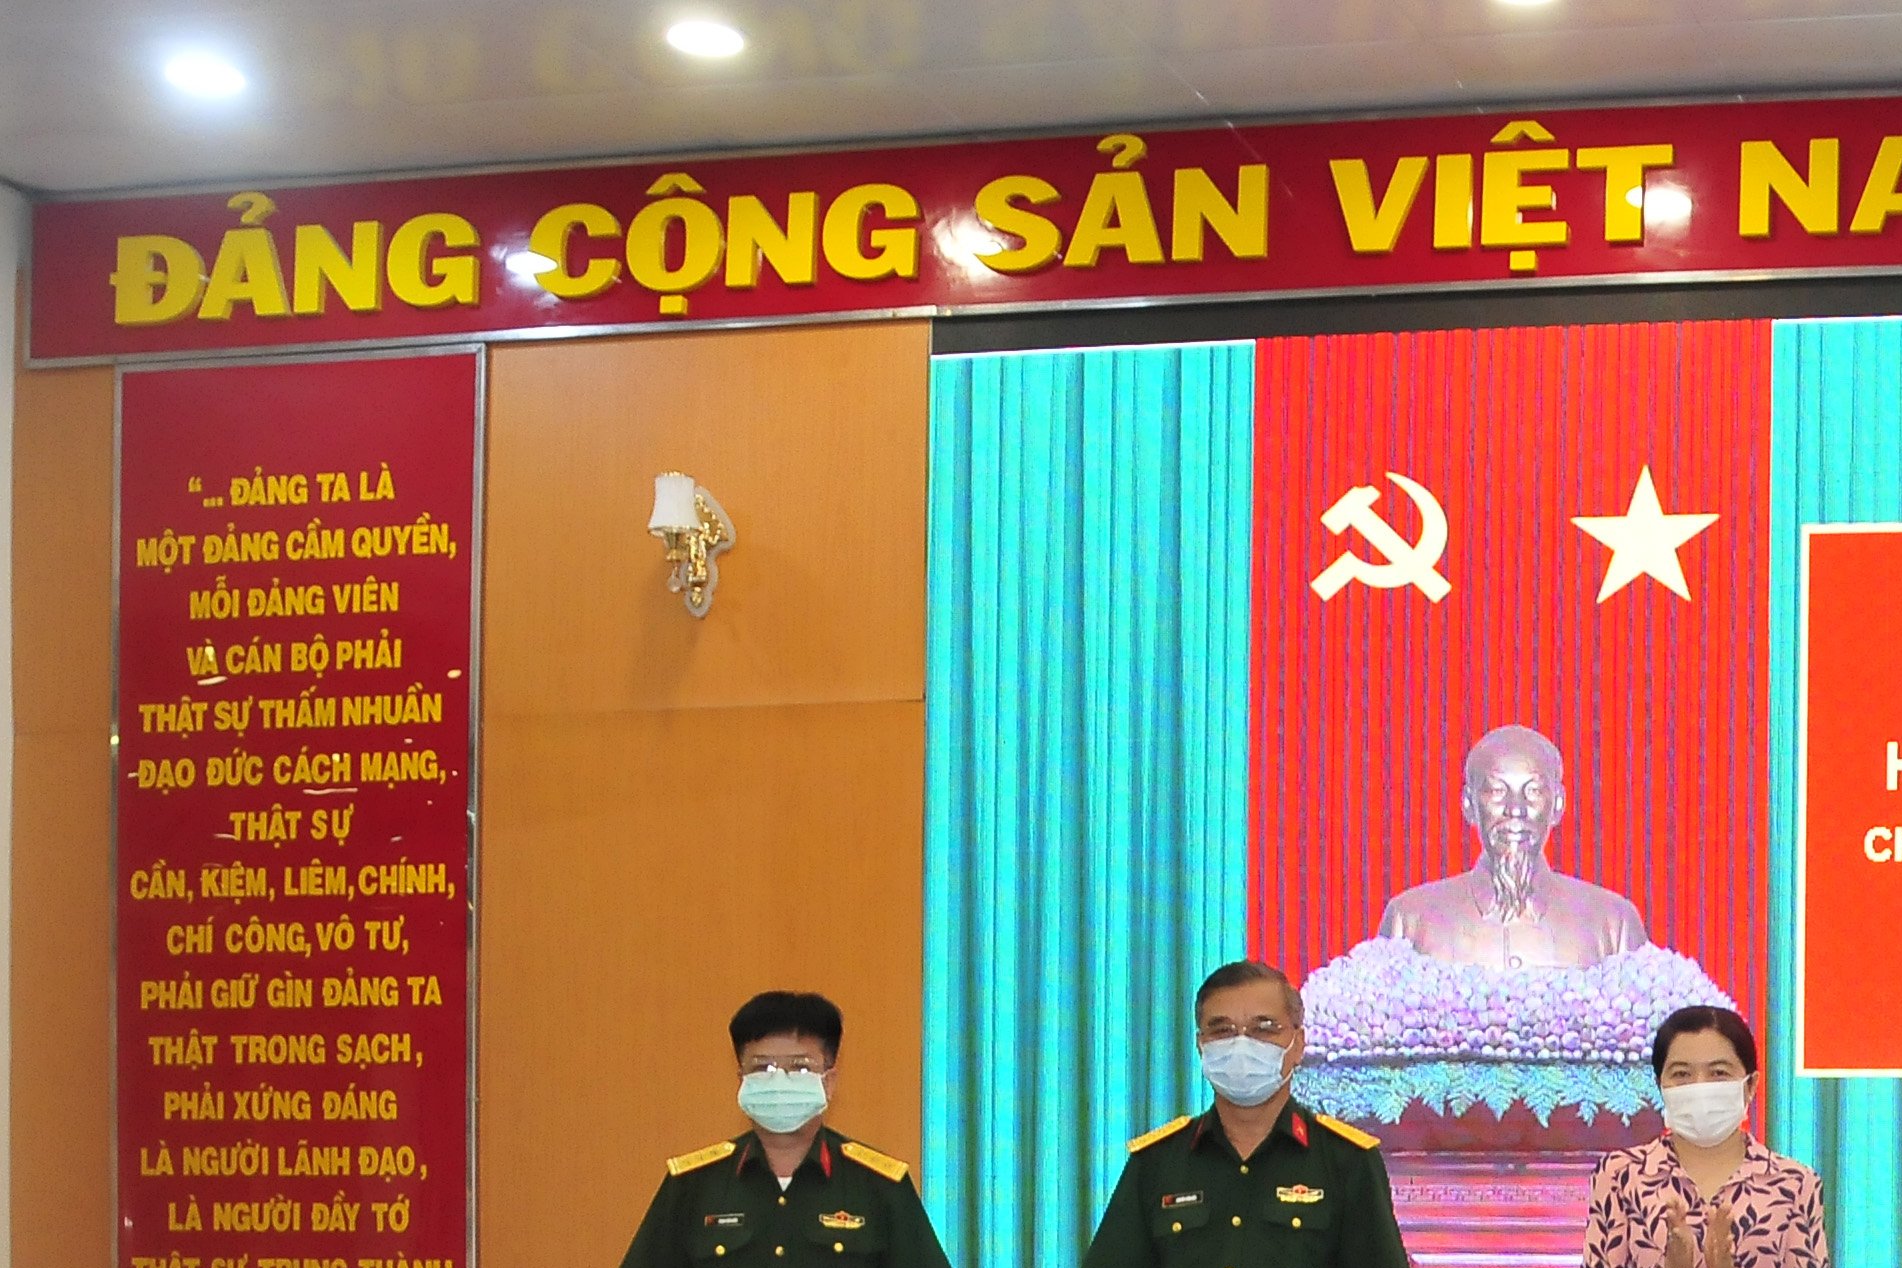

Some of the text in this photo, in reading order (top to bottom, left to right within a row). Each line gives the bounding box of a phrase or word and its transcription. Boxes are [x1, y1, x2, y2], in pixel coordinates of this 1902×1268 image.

[110, 190, 482, 326] ĐẢNG
[528, 172, 921, 316] CỘNG
[970, 133, 1270, 276] SẢN
[1329, 119, 1675, 272] VIỆT
[230, 466, 308, 506] ĐẢNG
[316, 472, 351, 502] TA
[360, 463, 395, 501] LÀ
[137, 512, 456, 573] MỘT ĐẢNG CẦM QUYỀN,
[190, 575, 398, 619] MỖI ĐẢNG VIÊN
[187, 629, 402, 678] VÀ CÁN BỘ PHẢI
[139, 683, 442, 738] THẬT SỰ THẤM NHUẦN
[137, 746, 446, 794] ĐẠO ĐỨC CÁCH MẠNG,
[230, 804, 354, 846] THẬT SỰ
[130, 856, 455, 904] CẦN, KIỆM, LIÊM, CHÍNH,
[167, 917, 212, 954] CHÍ
[316, 914, 354, 951] VÔ
[365, 915, 408, 954] TƯ,
[141, 967, 442, 1009] PHẢI GIỮ GÌN ĐẢNG TA
[149, 1029, 422, 1069] THẬT TRONG SẠCH,
[164, 1083, 397, 1120] PHẢI XỨNG ĐÁNG
[140, 1141, 173, 1176] LÀ
[183, 1142, 268, 1175] NGƯỜI
[278, 1140, 350, 1175] LÃNH
[169, 1192, 409, 1232] LÀ NGƯỜI ĐẦY TỚ
